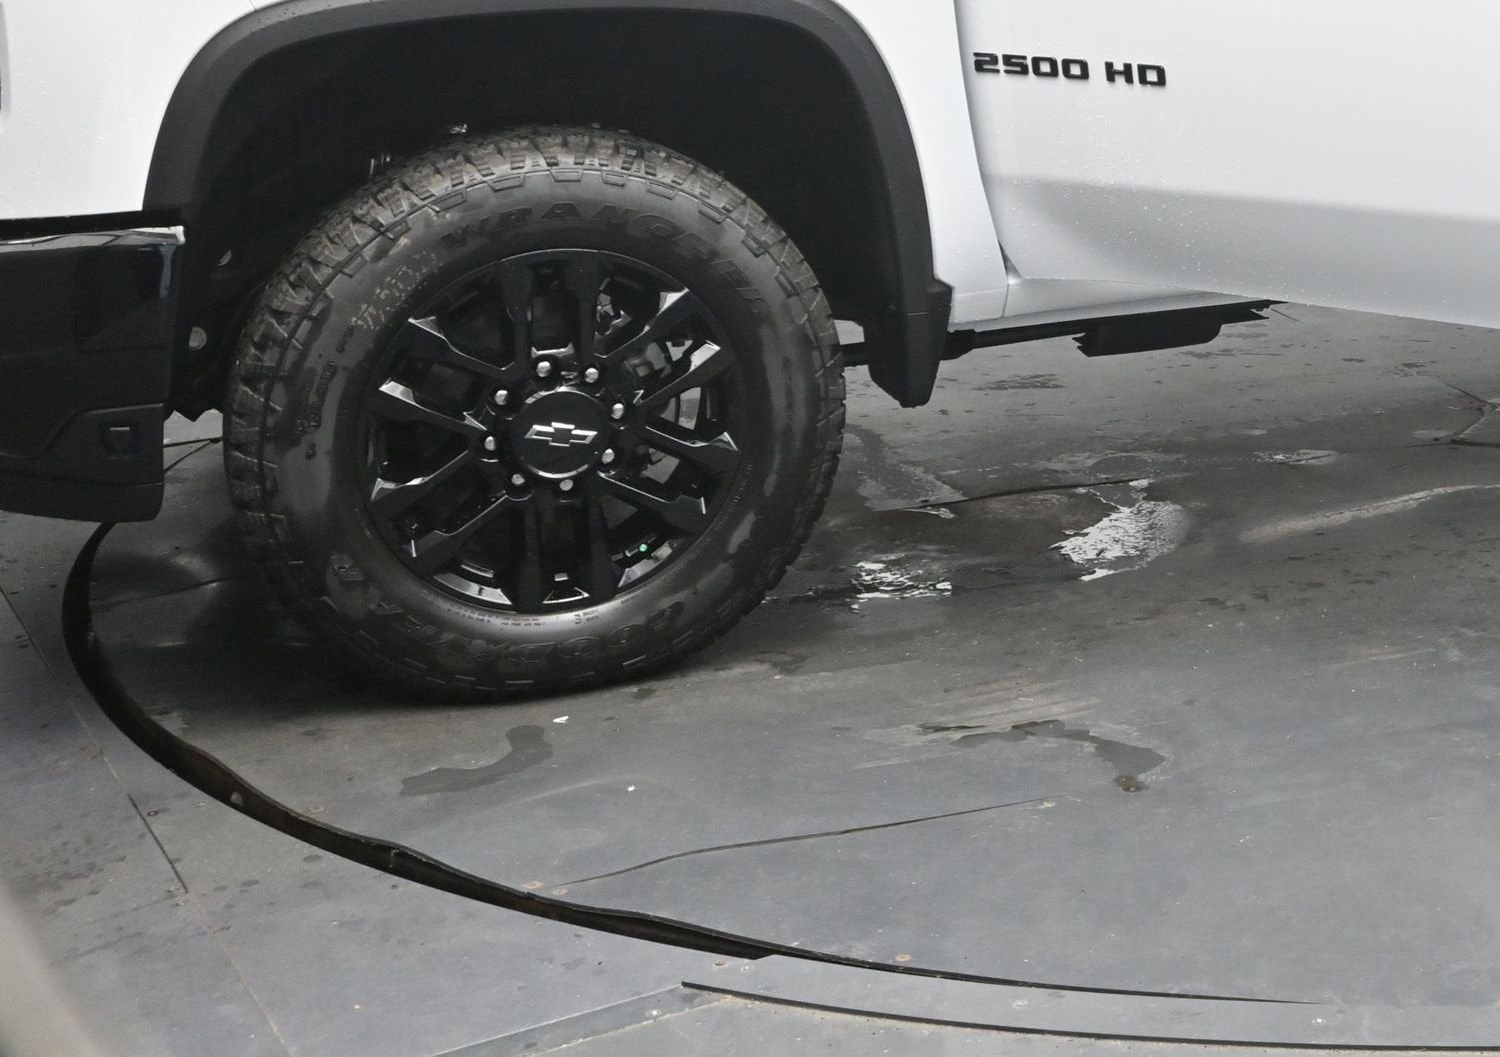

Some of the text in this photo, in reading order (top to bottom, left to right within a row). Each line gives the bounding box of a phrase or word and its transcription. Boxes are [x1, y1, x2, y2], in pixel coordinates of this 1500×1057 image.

[972, 52, 1167, 87] 2500 HD
[439, 201, 767, 313] WRANGLER
